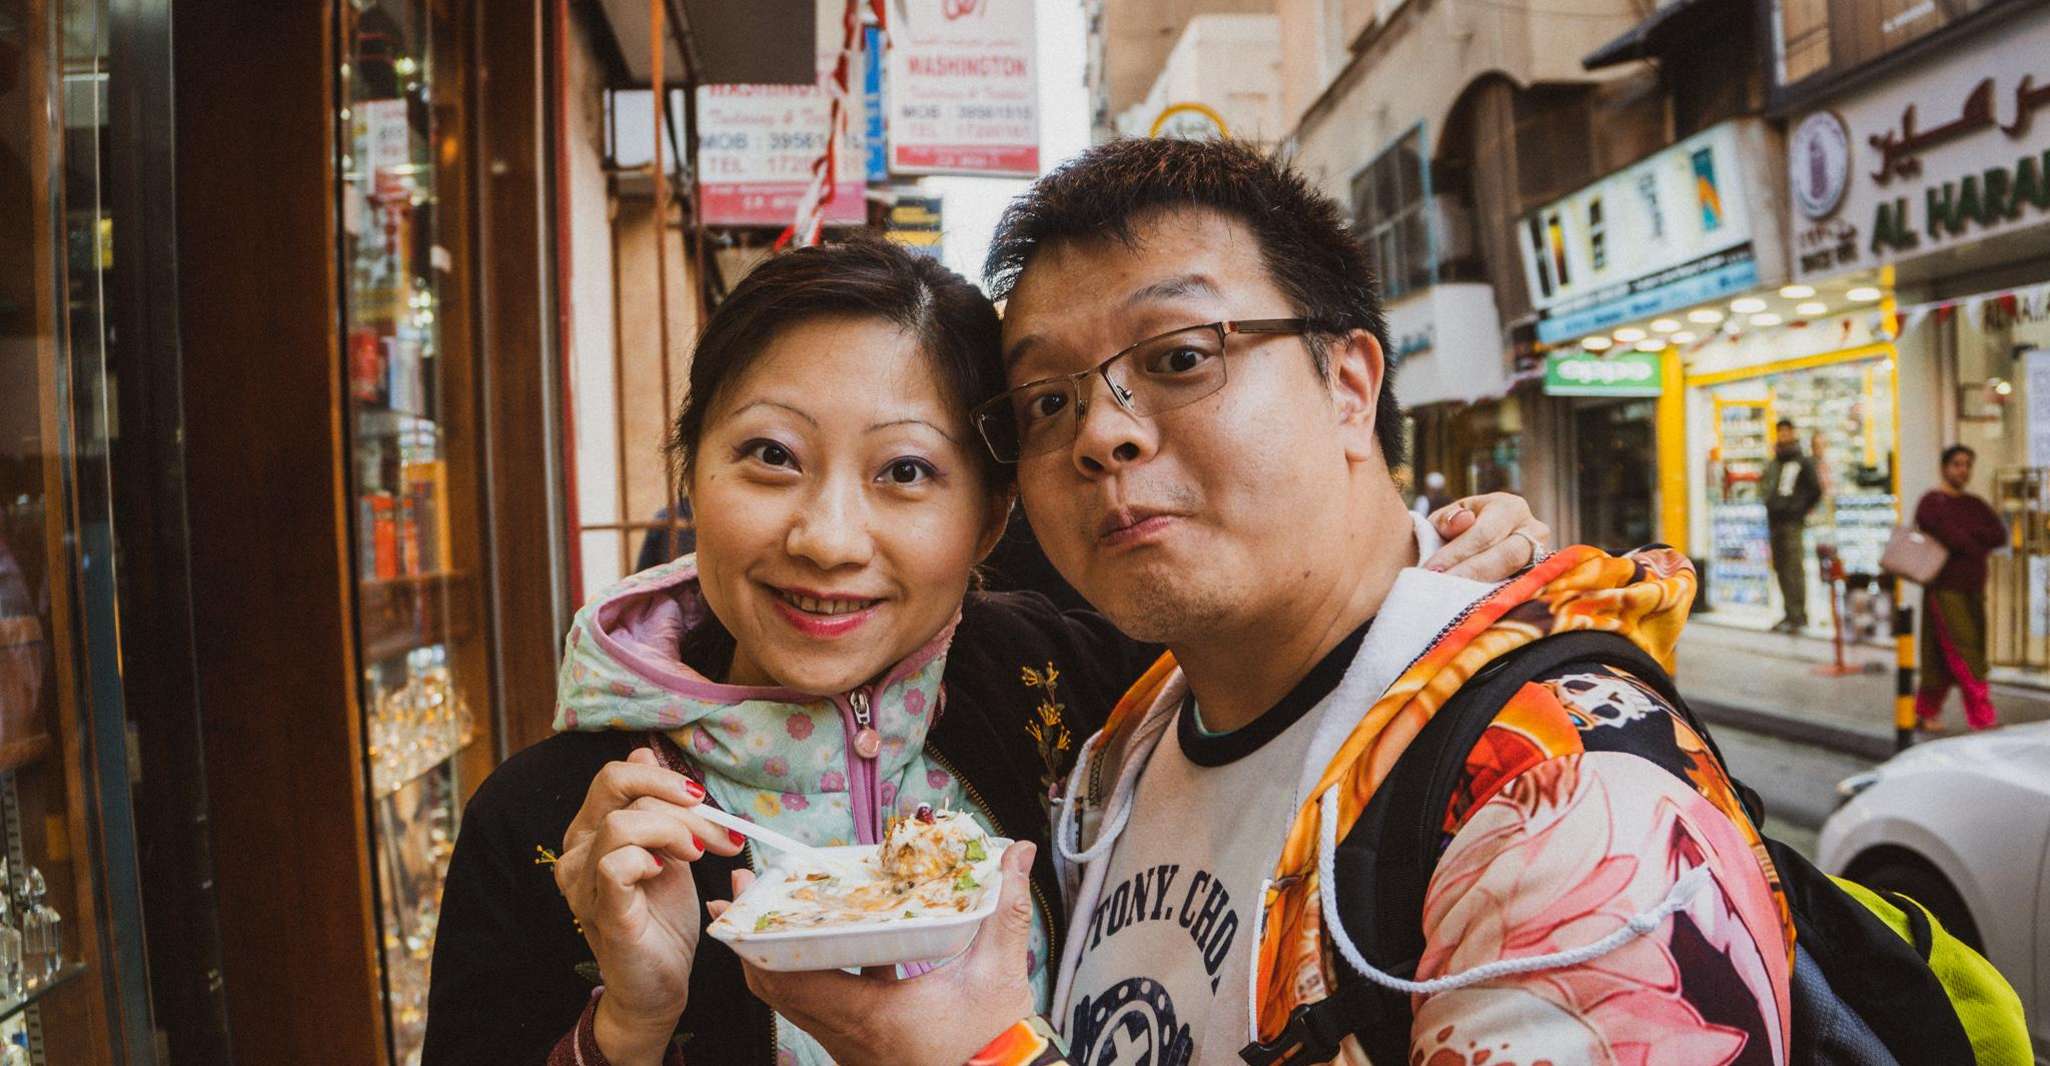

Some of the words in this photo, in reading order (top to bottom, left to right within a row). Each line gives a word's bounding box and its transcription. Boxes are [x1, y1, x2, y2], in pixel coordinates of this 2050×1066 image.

[908, 56, 1027, 77] WASHINGTON
[1872, 196, 1919, 255] AL
[1927, 149, 2050, 240] HARA
[1090, 864, 1180, 953] TONY.
[1179, 869, 1239, 998] CHO
